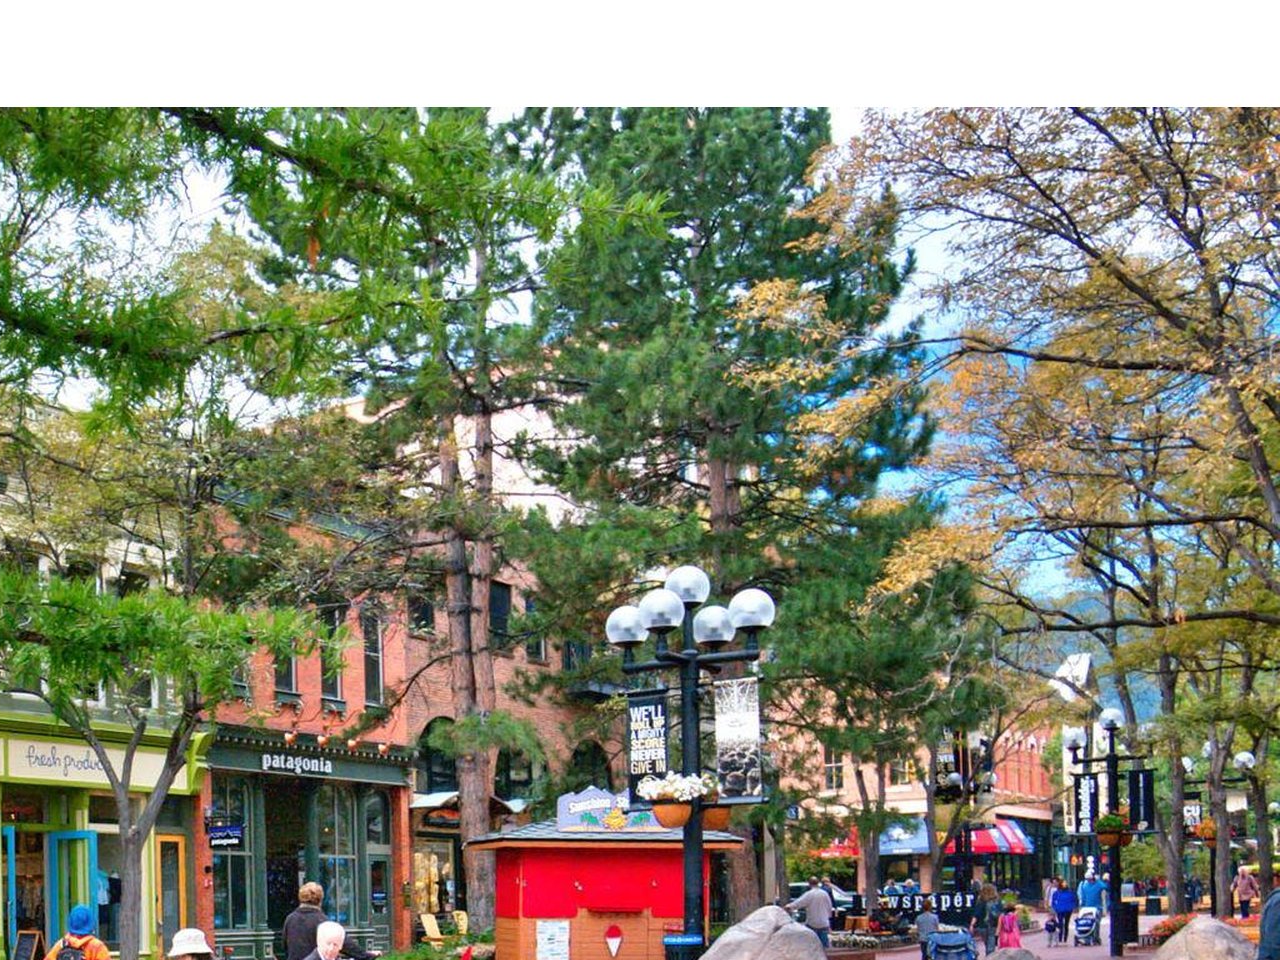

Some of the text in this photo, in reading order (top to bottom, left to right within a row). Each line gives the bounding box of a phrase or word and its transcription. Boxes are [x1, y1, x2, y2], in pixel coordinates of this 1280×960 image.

[631, 738, 665, 750] SCORE
[26, 745, 104, 777] fresh produc
[631, 749, 665, 761] NEVER
[262, 754, 333, 773] patagonia
[631, 759, 666, 774] GIVE IN
[861, 893, 974, 911] wspaper
